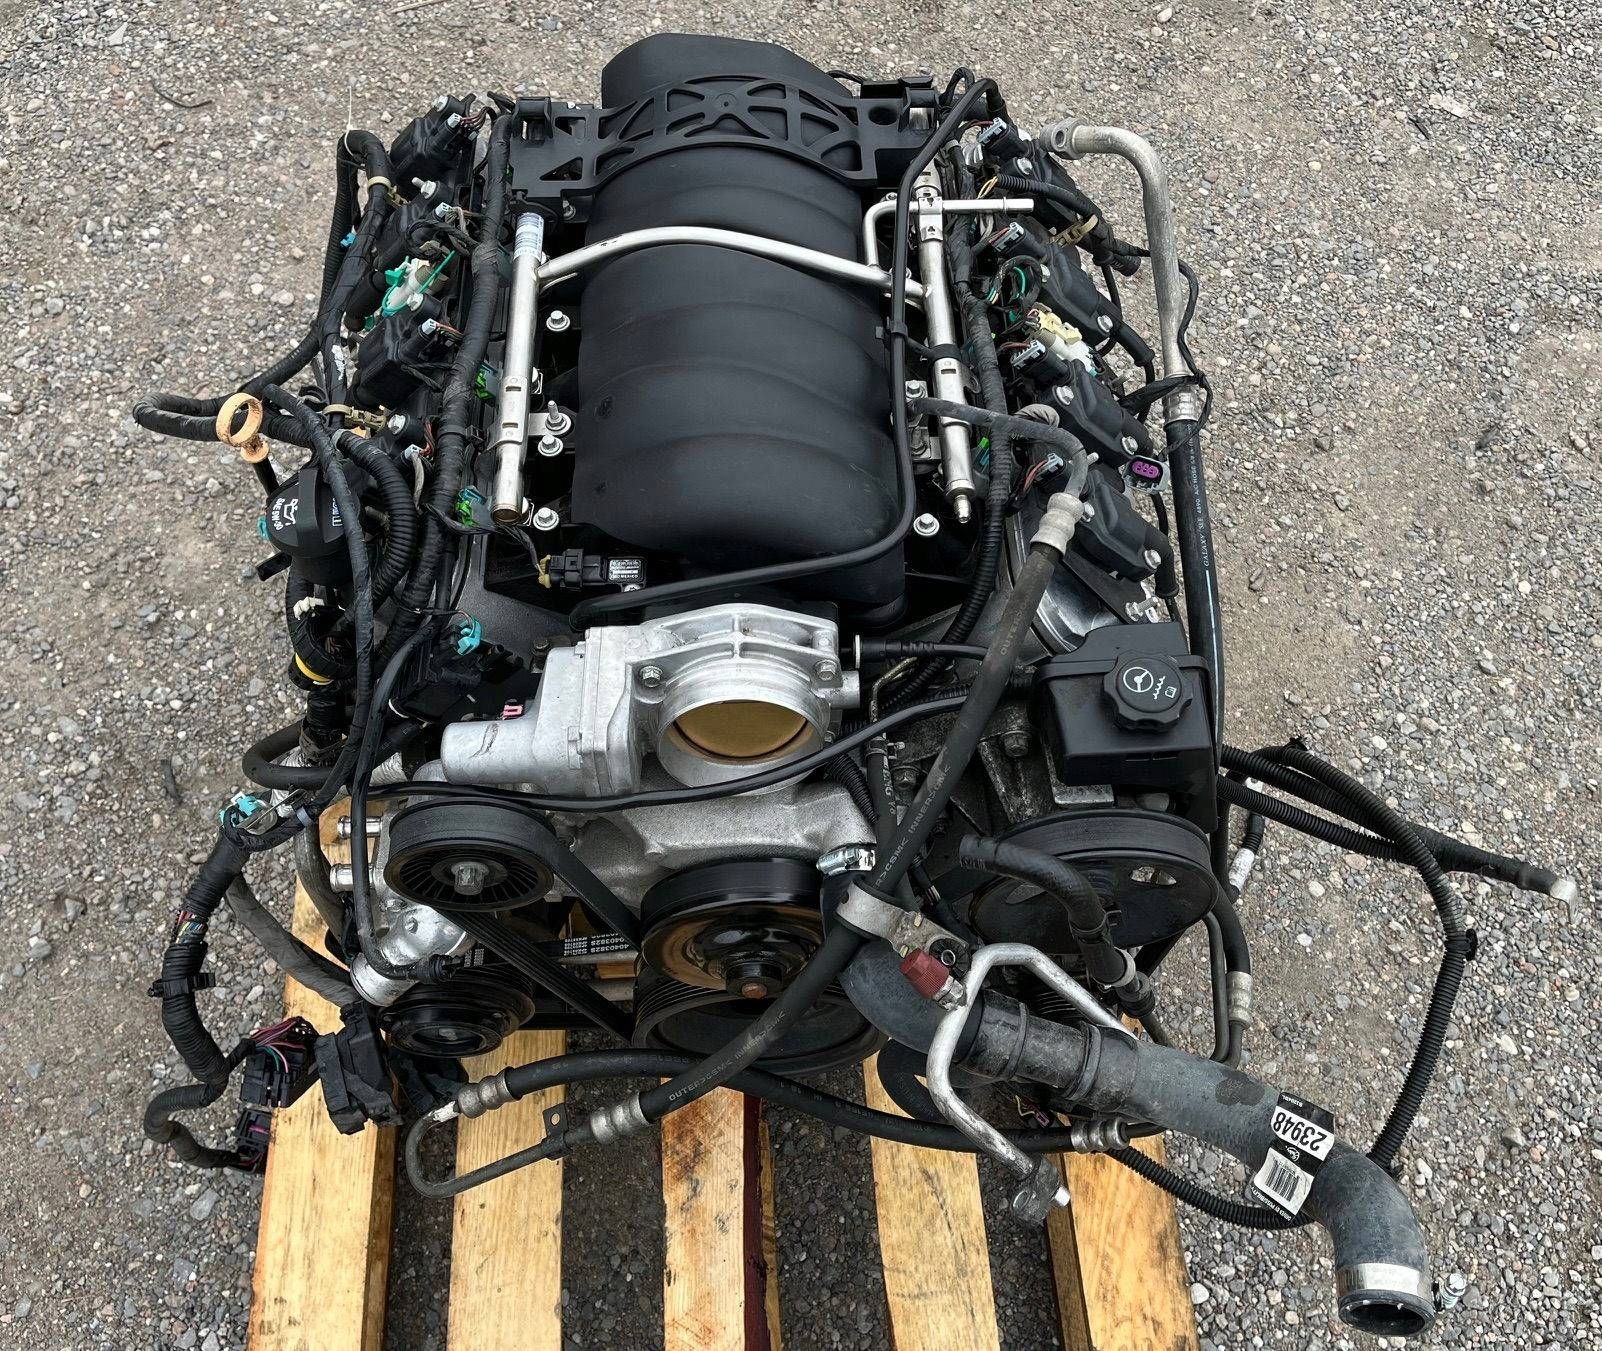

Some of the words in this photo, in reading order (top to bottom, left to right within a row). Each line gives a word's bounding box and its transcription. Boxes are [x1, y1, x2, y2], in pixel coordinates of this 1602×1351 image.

[273, 497, 286, 511] SAE
[271, 511, 284, 531] 5W-30
[1200, 533, 1209, 567] GALAXY
[1273, 1112, 1328, 1152] 23948
